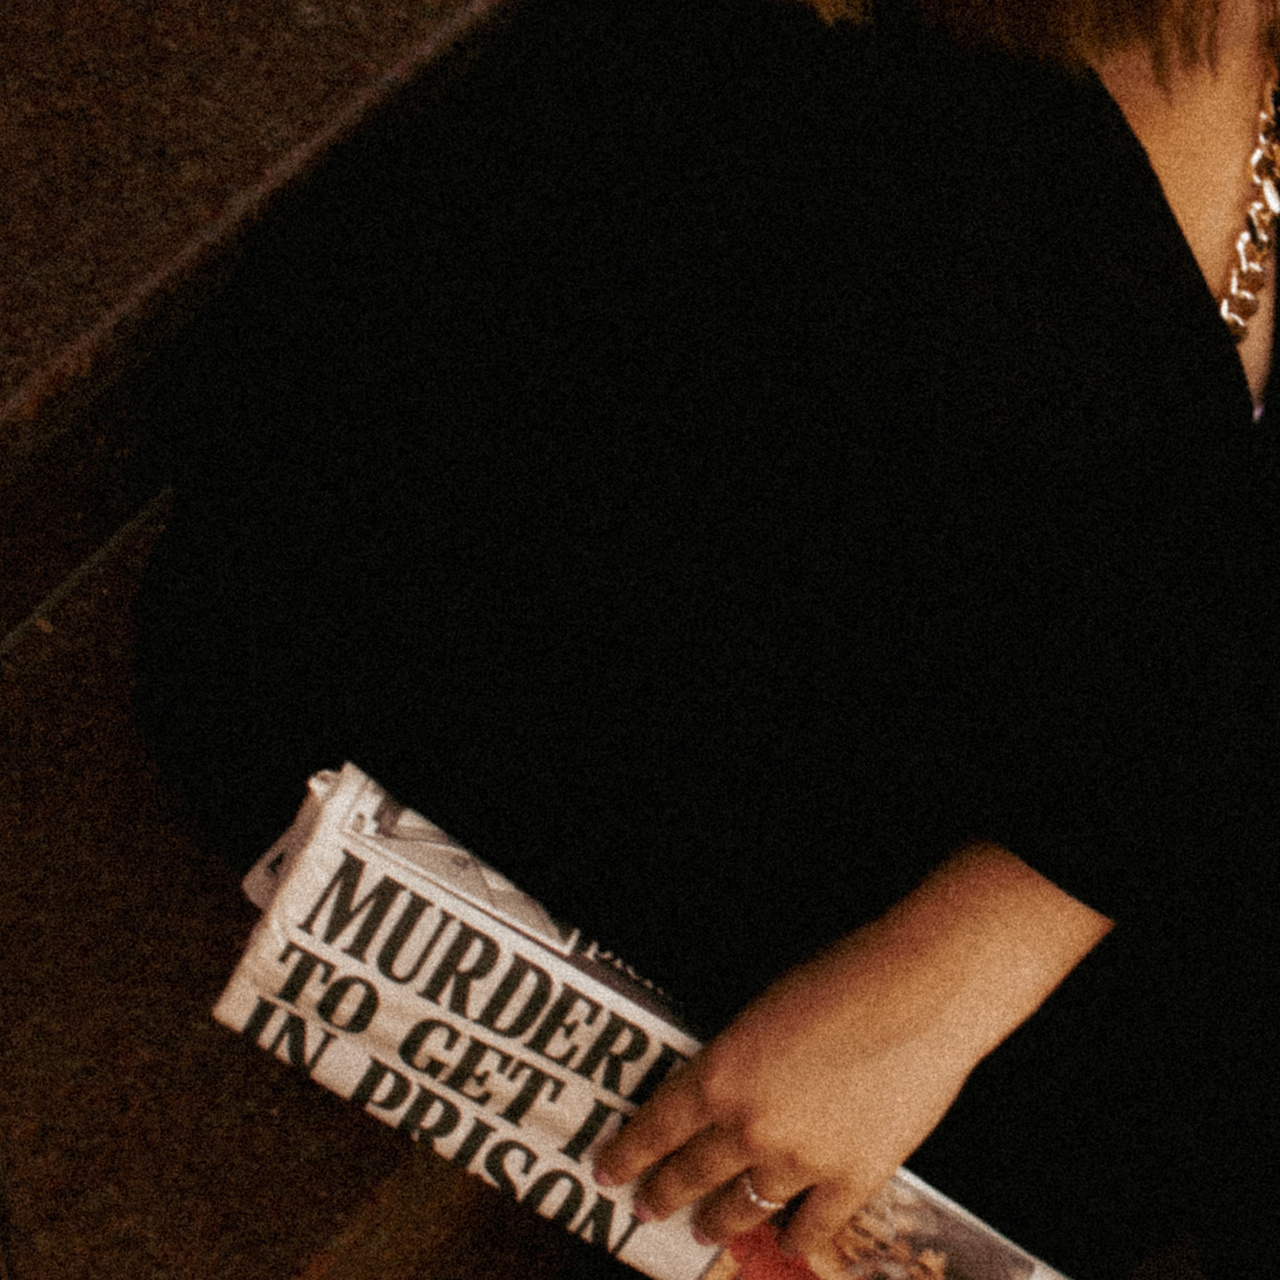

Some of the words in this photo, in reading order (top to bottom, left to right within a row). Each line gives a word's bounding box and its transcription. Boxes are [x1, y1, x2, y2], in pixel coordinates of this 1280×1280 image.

[242, 995, 339, 1070] IN
[350, 1055, 642, 1253] PRISON
[278, 940, 380, 1035] TO
[399, 1018, 566, 1127] GET
